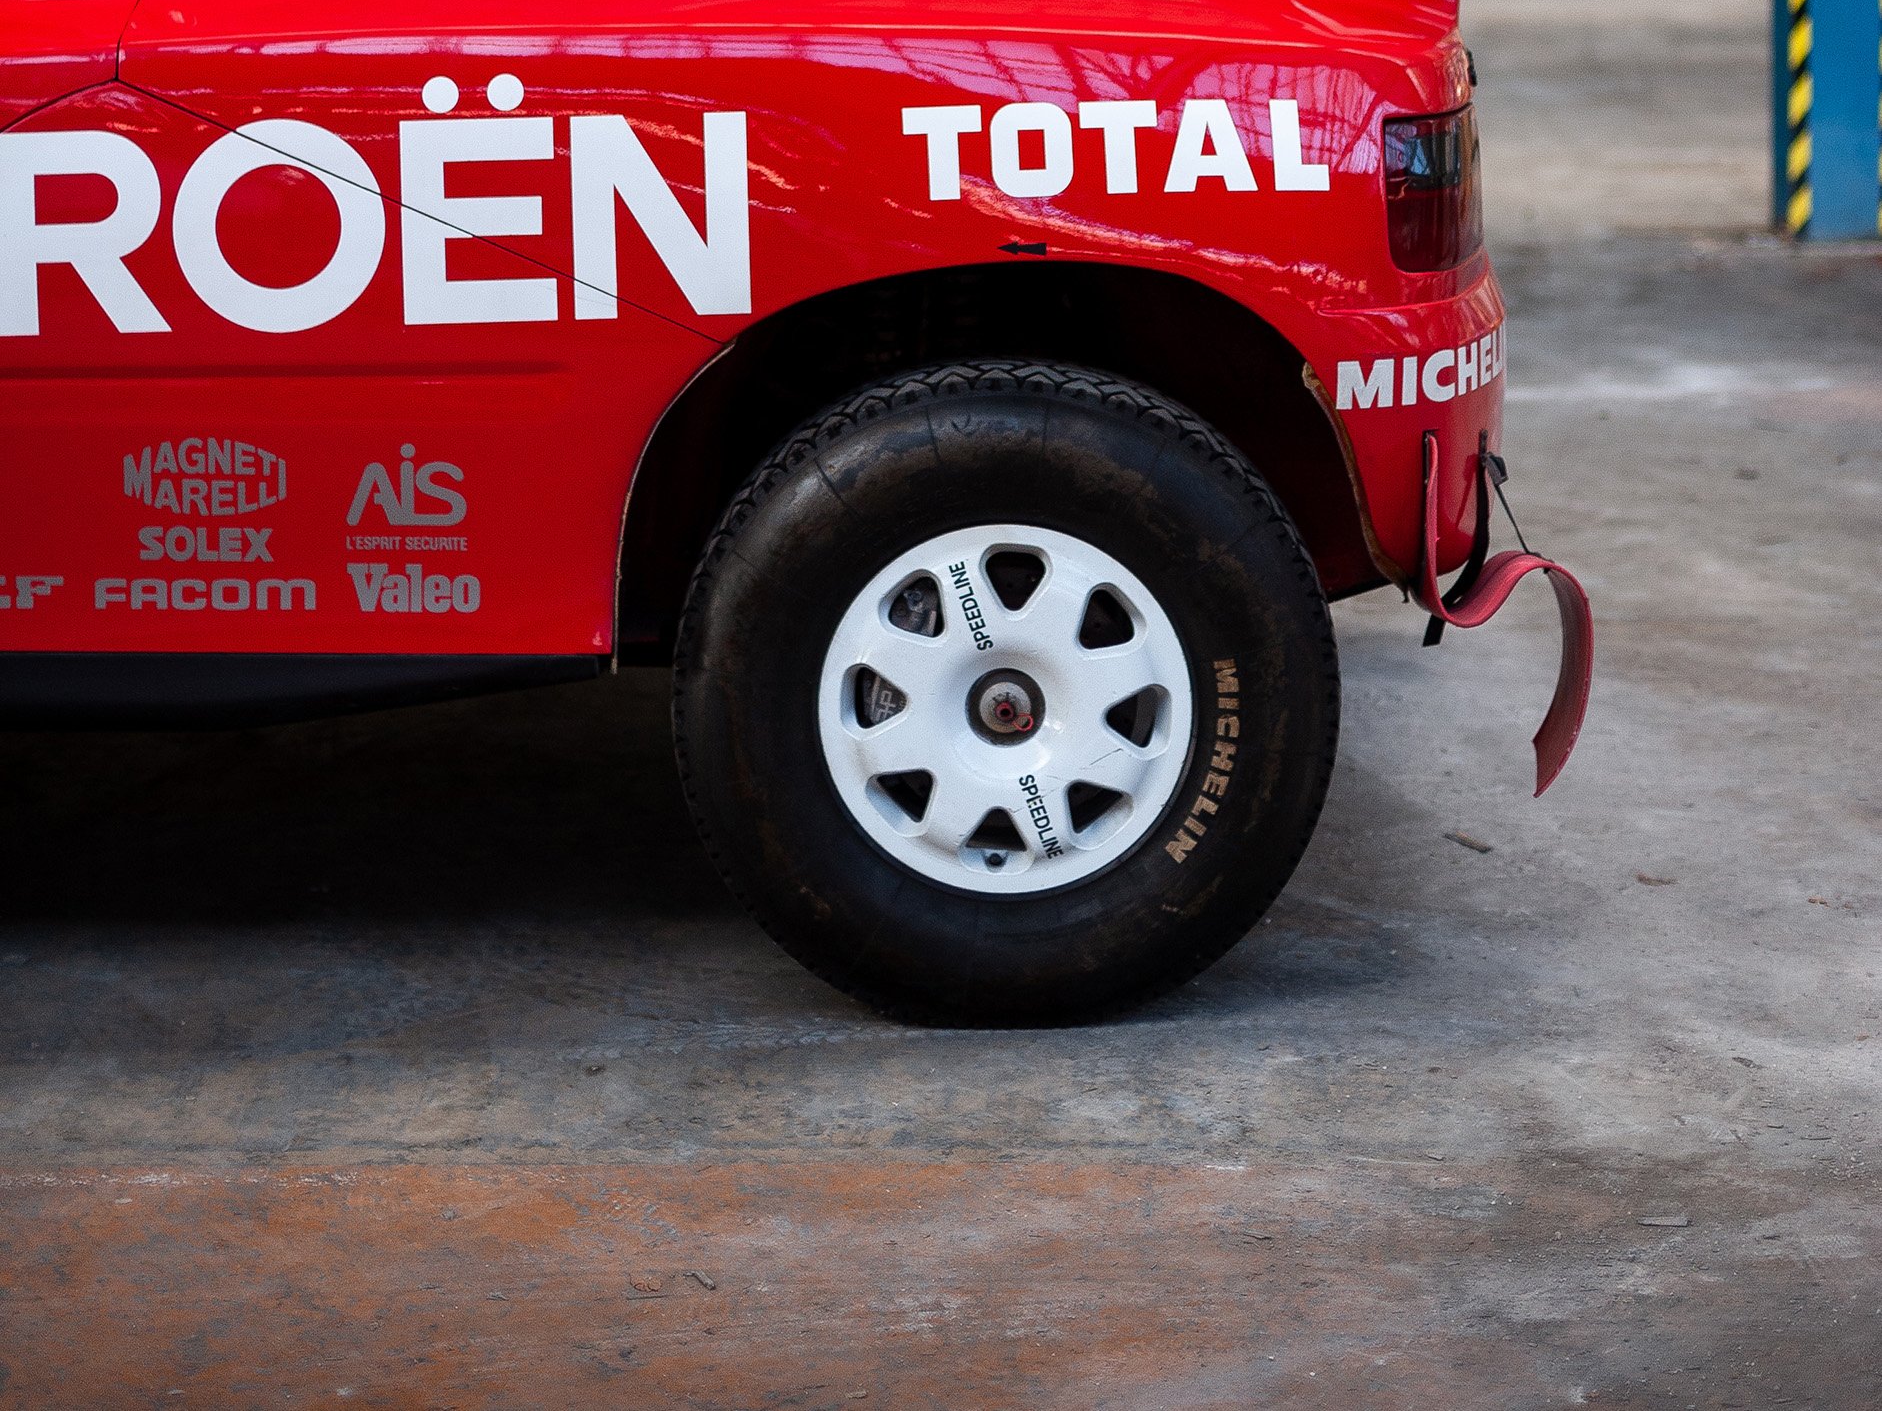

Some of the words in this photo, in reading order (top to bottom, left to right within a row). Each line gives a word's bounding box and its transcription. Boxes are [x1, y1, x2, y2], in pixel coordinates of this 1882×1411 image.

[901, 99, 1331, 201] TOTAL
[0, 73, 752, 337] ROËN
[123, 437, 287, 482] MAGNETI
[138, 526, 273, 563] SOLEX
[345, 535, 401, 550] L'ESPRIT
[94, 577, 317, 611] FACOM
[346, 562, 481, 613] Valeo
[948, 561, 994, 651] SPEEDLINE
[1165, 658, 1240, 864] MICHELIN
[1018, 774, 1064, 860] SPEEDLINE
